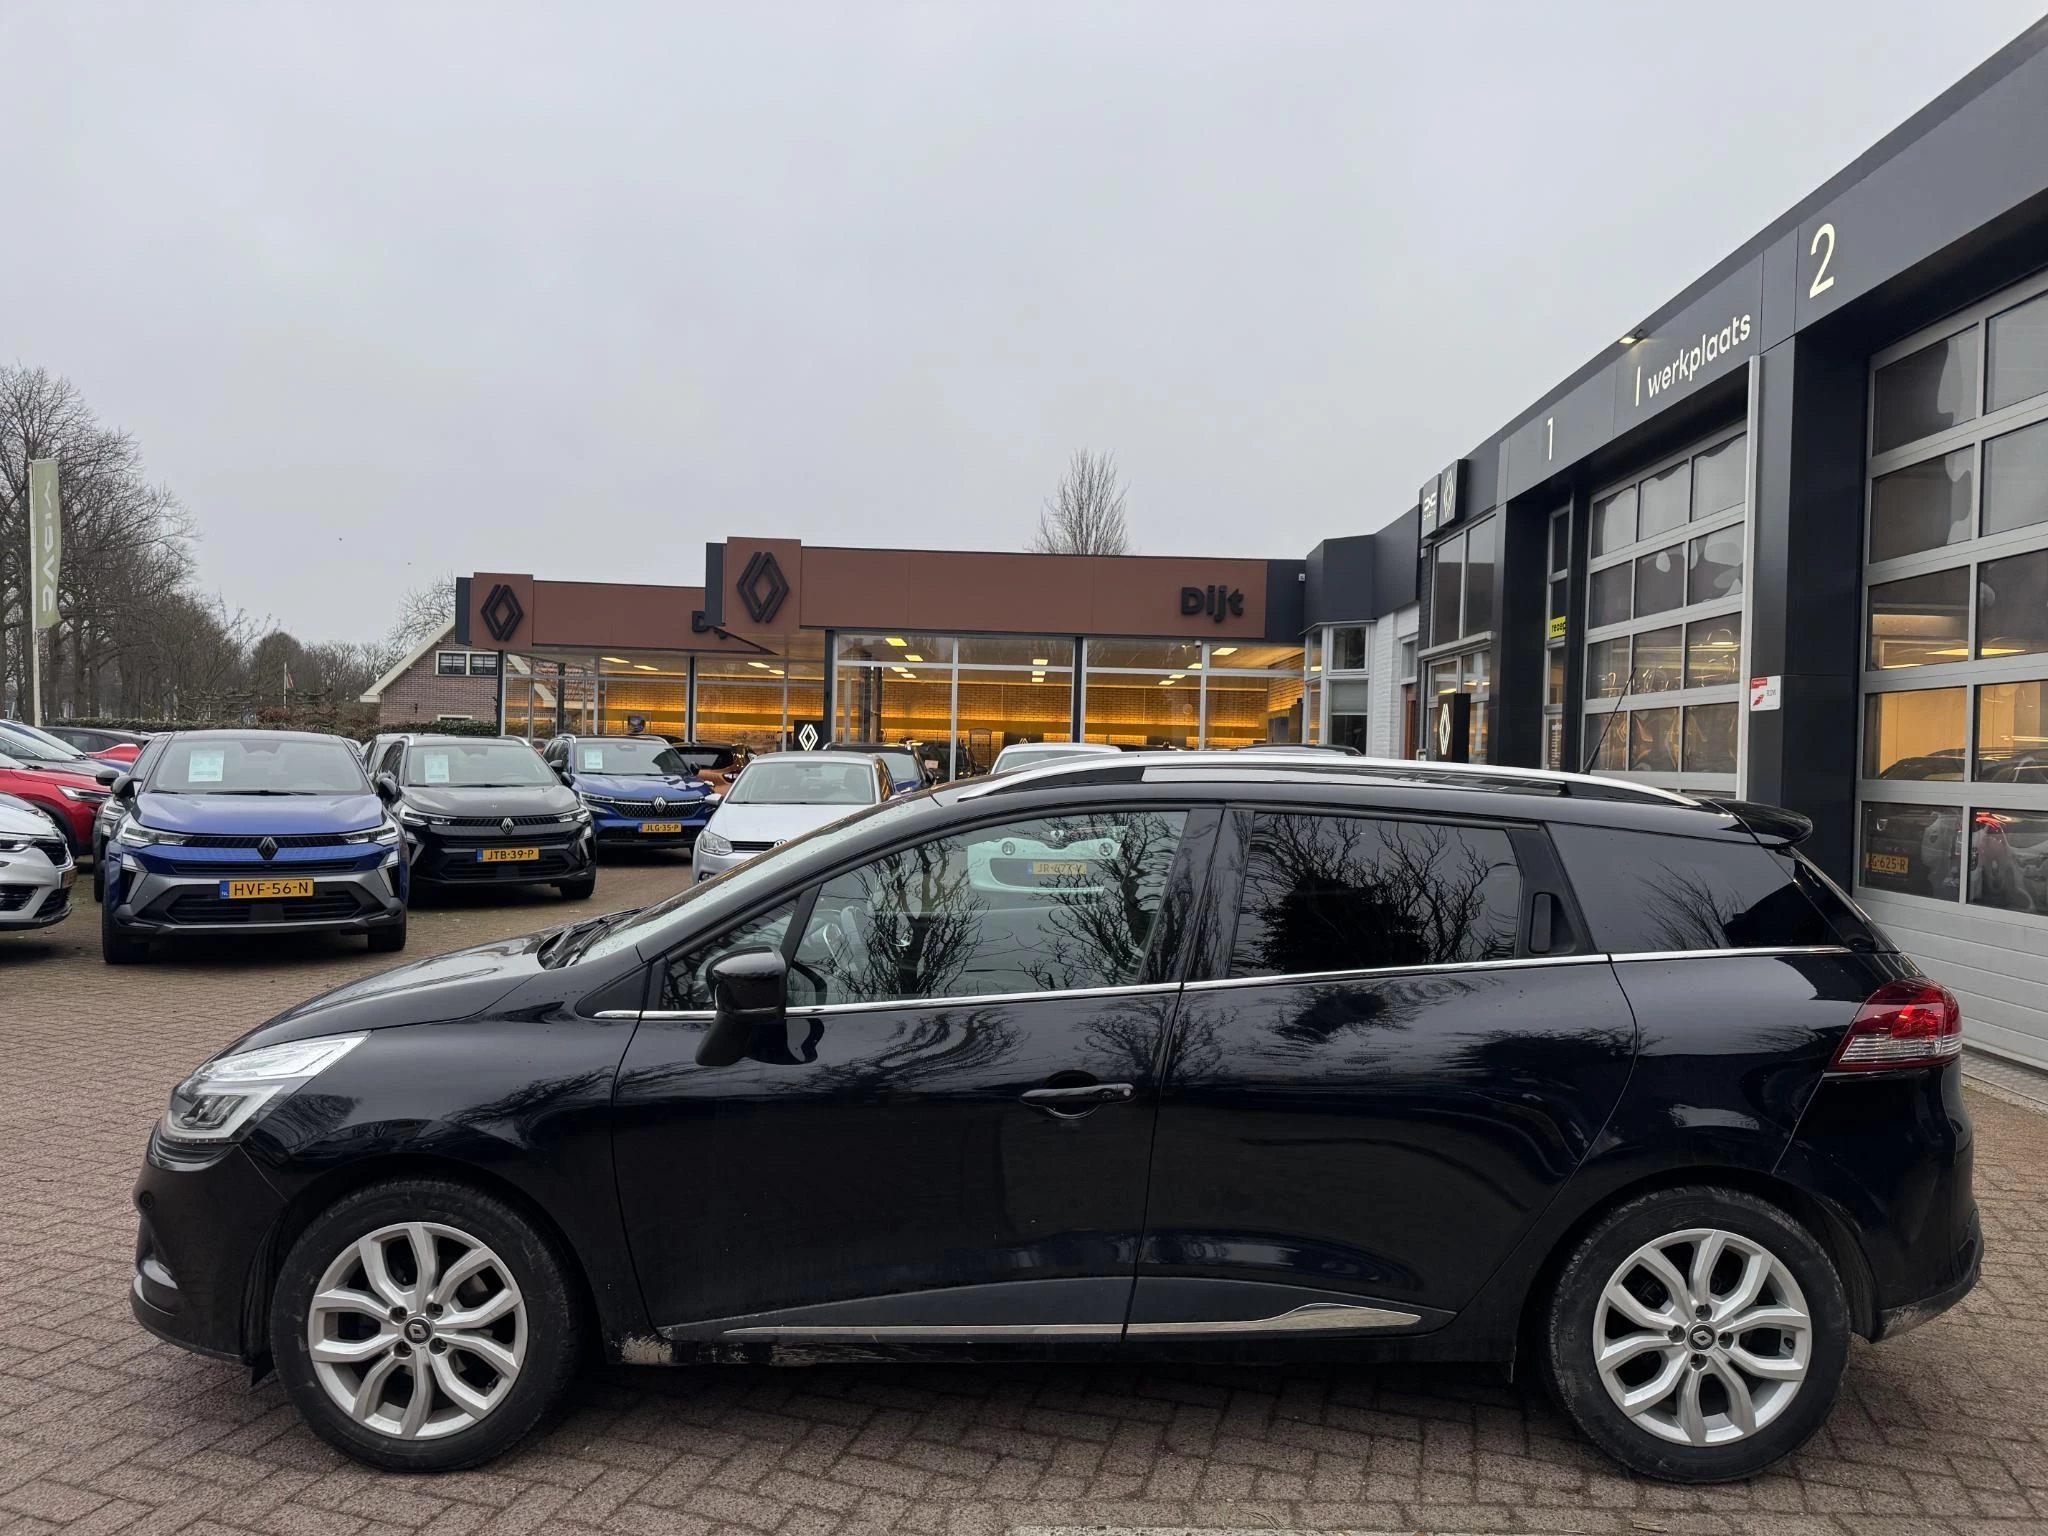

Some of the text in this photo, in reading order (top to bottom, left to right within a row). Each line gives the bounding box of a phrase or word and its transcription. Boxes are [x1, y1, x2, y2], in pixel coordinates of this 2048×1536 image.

[1809, 223, 1835, 299] 2
[1647, 314, 1751, 398] werkplaats
[1547, 417, 1554, 461] 1
[1181, 585, 1244, 623] Dijt
[488, 850, 534, 860] JTB-39-P
[234, 882, 308, 896] HVF-56-N
